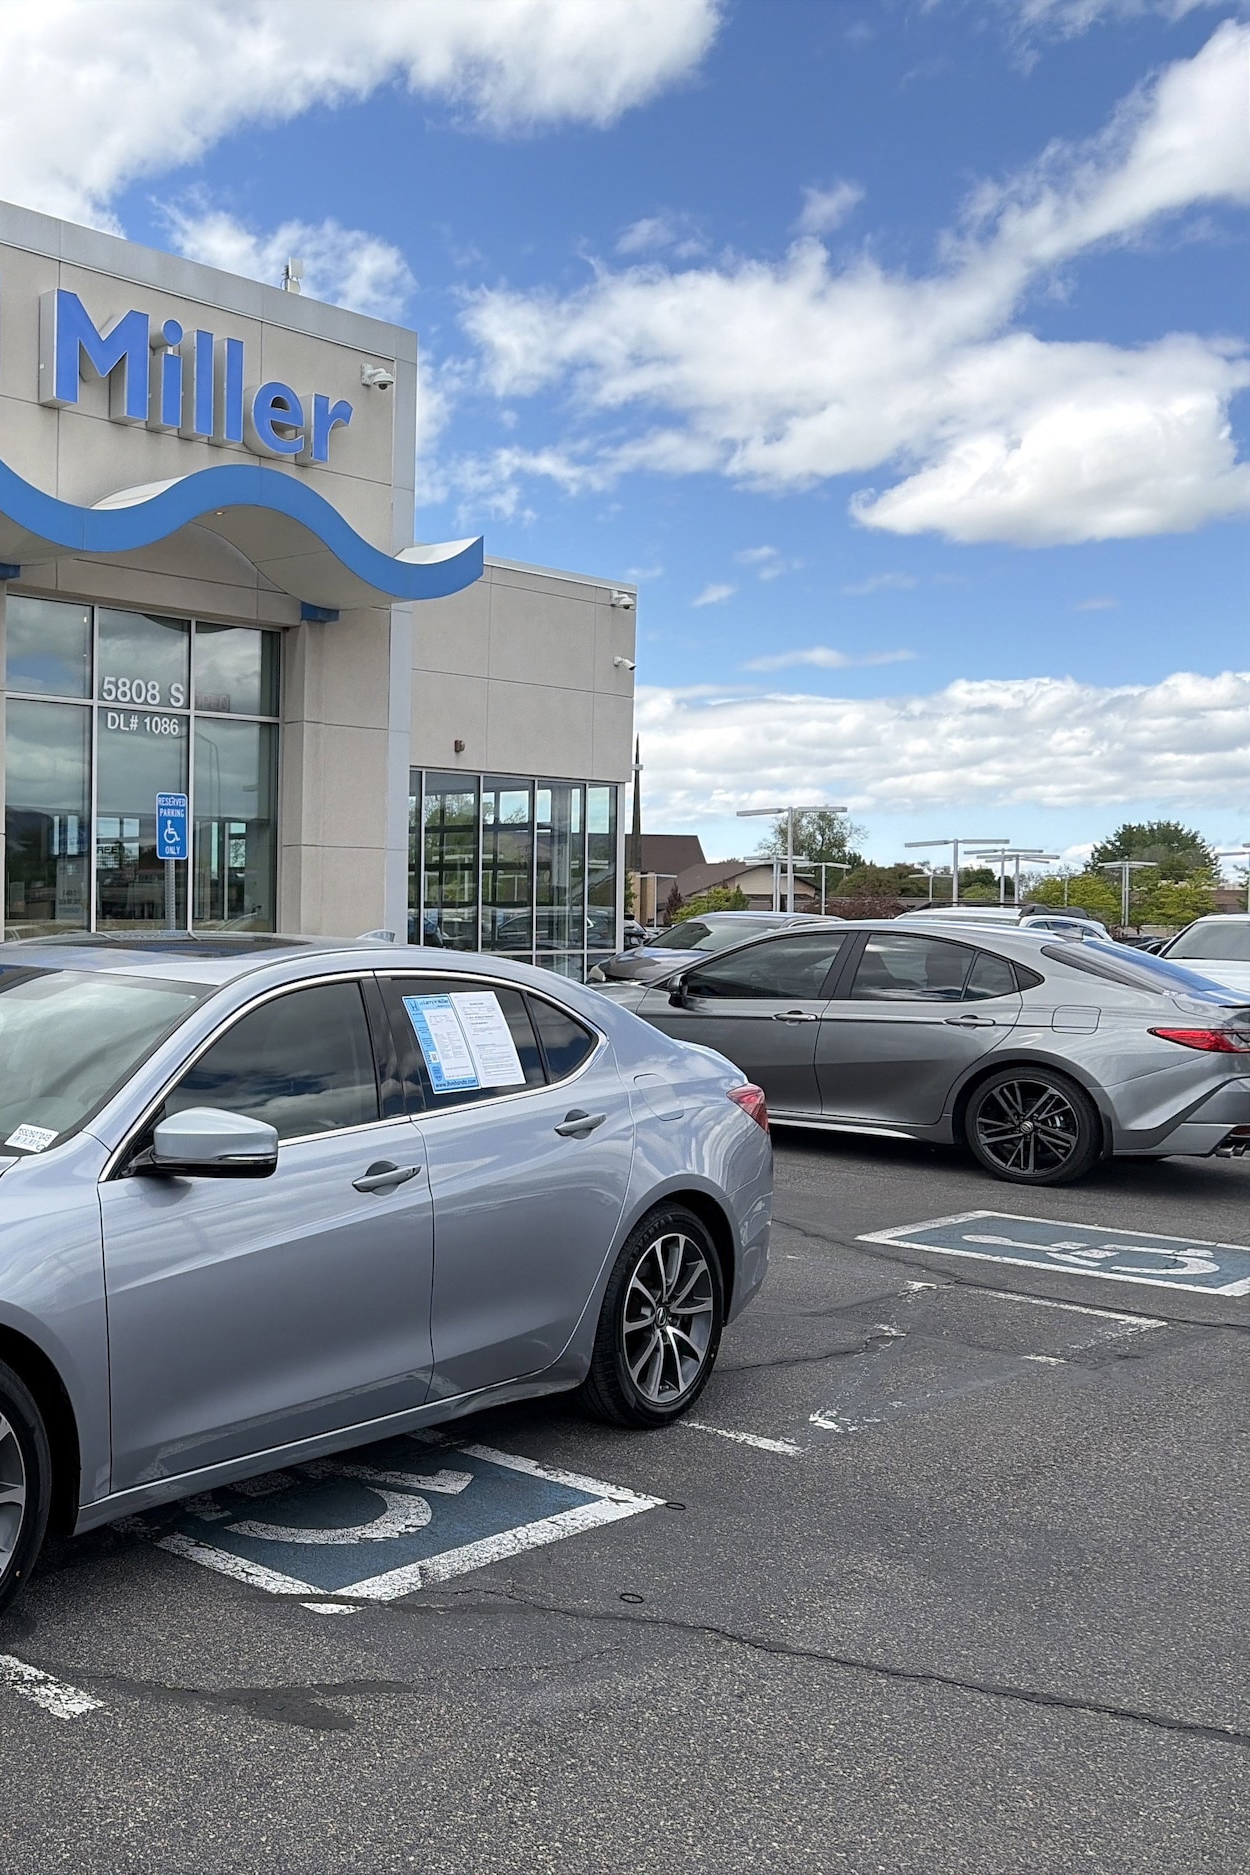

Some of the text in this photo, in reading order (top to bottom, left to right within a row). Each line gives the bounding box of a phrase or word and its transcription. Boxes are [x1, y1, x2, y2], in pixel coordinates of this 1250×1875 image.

[40, 288, 353, 464] Miller
[102, 676, 161, 705] 5808
[170, 682, 184, 707] S
[107, 712, 179, 735] DL# 1086
[158, 796, 186, 807] RESERVED
[159, 808, 185, 818] PARKING
[165, 846, 181, 855] ONLY
